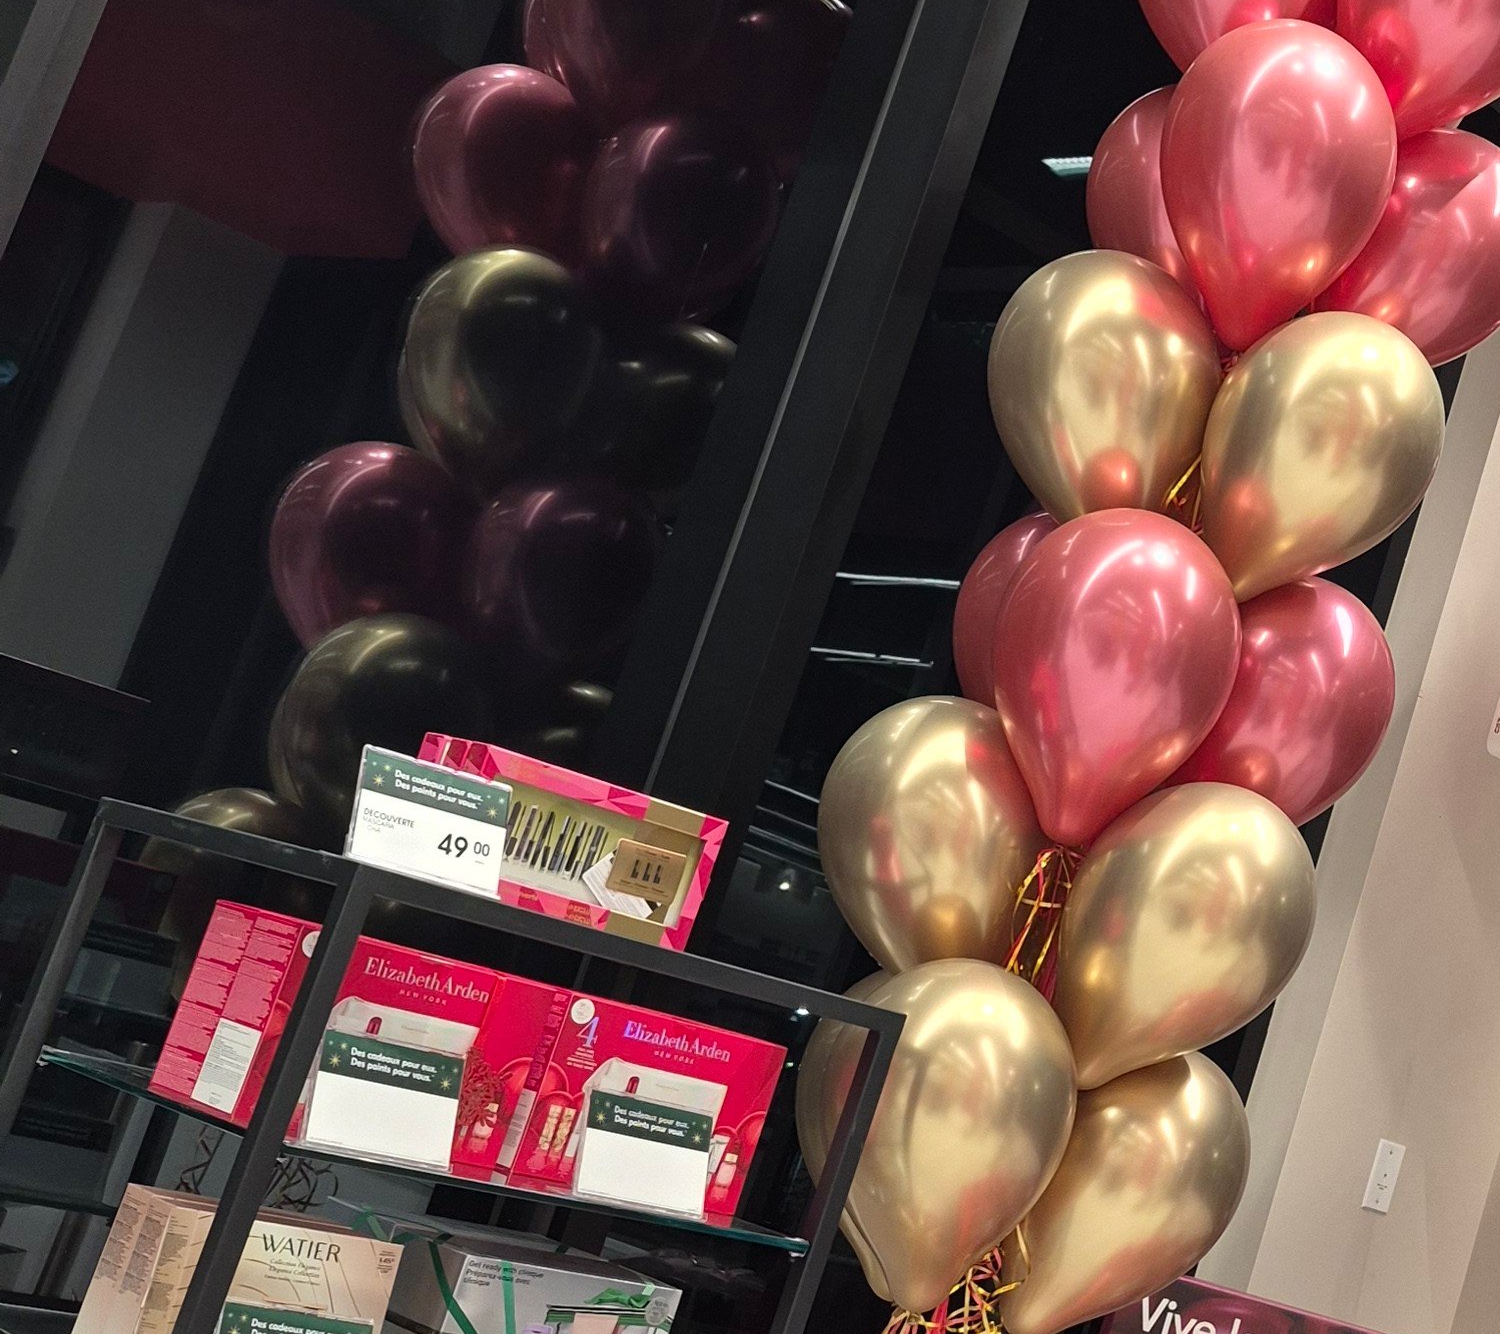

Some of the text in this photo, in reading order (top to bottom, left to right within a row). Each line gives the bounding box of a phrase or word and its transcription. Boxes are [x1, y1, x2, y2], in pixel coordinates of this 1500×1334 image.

[395, 769, 410, 780] Des
[411, 776, 445, 790] cadeaux
[447, 785, 465, 797] pour
[395, 779, 457, 804] Des points pour
[438, 833, 490, 858] 49 00
[364, 956, 490, 1003] Elizabeth Arden
[400, 989, 447, 1005] NEW YORK
[623, 1020, 731, 1062] Elizabeth Arden
[262, 1233, 341, 1263] WATIER
[251, 1318, 267, 1328] Des
[269, 1322, 303, 1334] cadeaux
